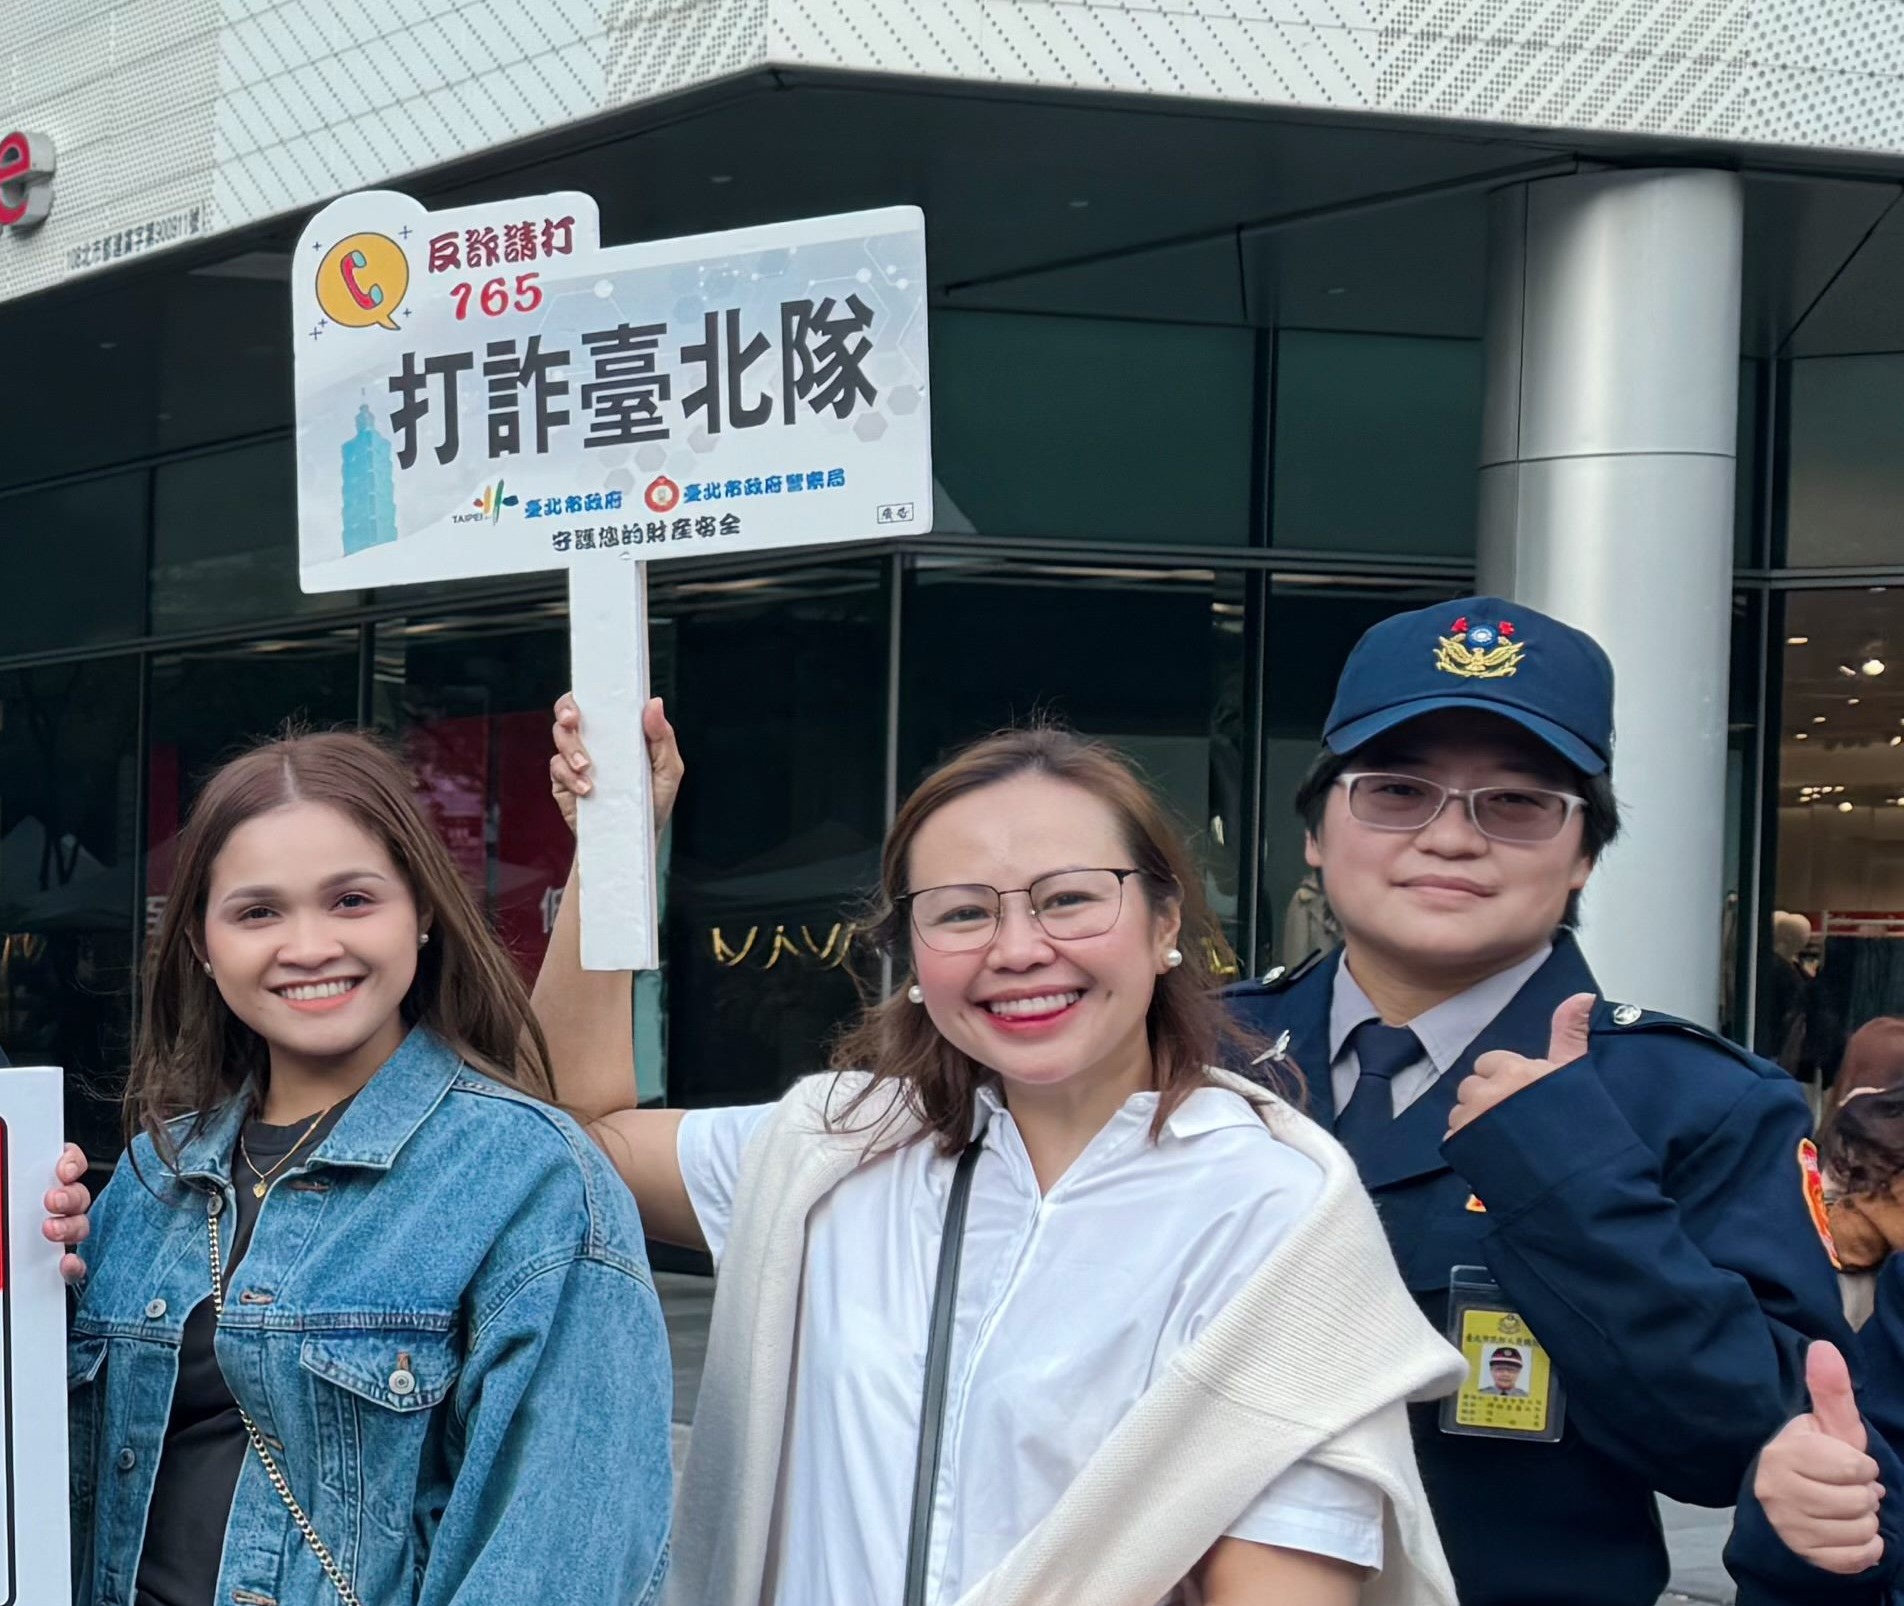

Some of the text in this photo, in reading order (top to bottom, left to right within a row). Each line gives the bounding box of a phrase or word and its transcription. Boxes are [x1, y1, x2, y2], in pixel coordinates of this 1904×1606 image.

[428, 215, 576, 274] 反詐請打
[450, 272, 543, 321] 165
[388, 294, 879, 470] 打詐臺北隊
